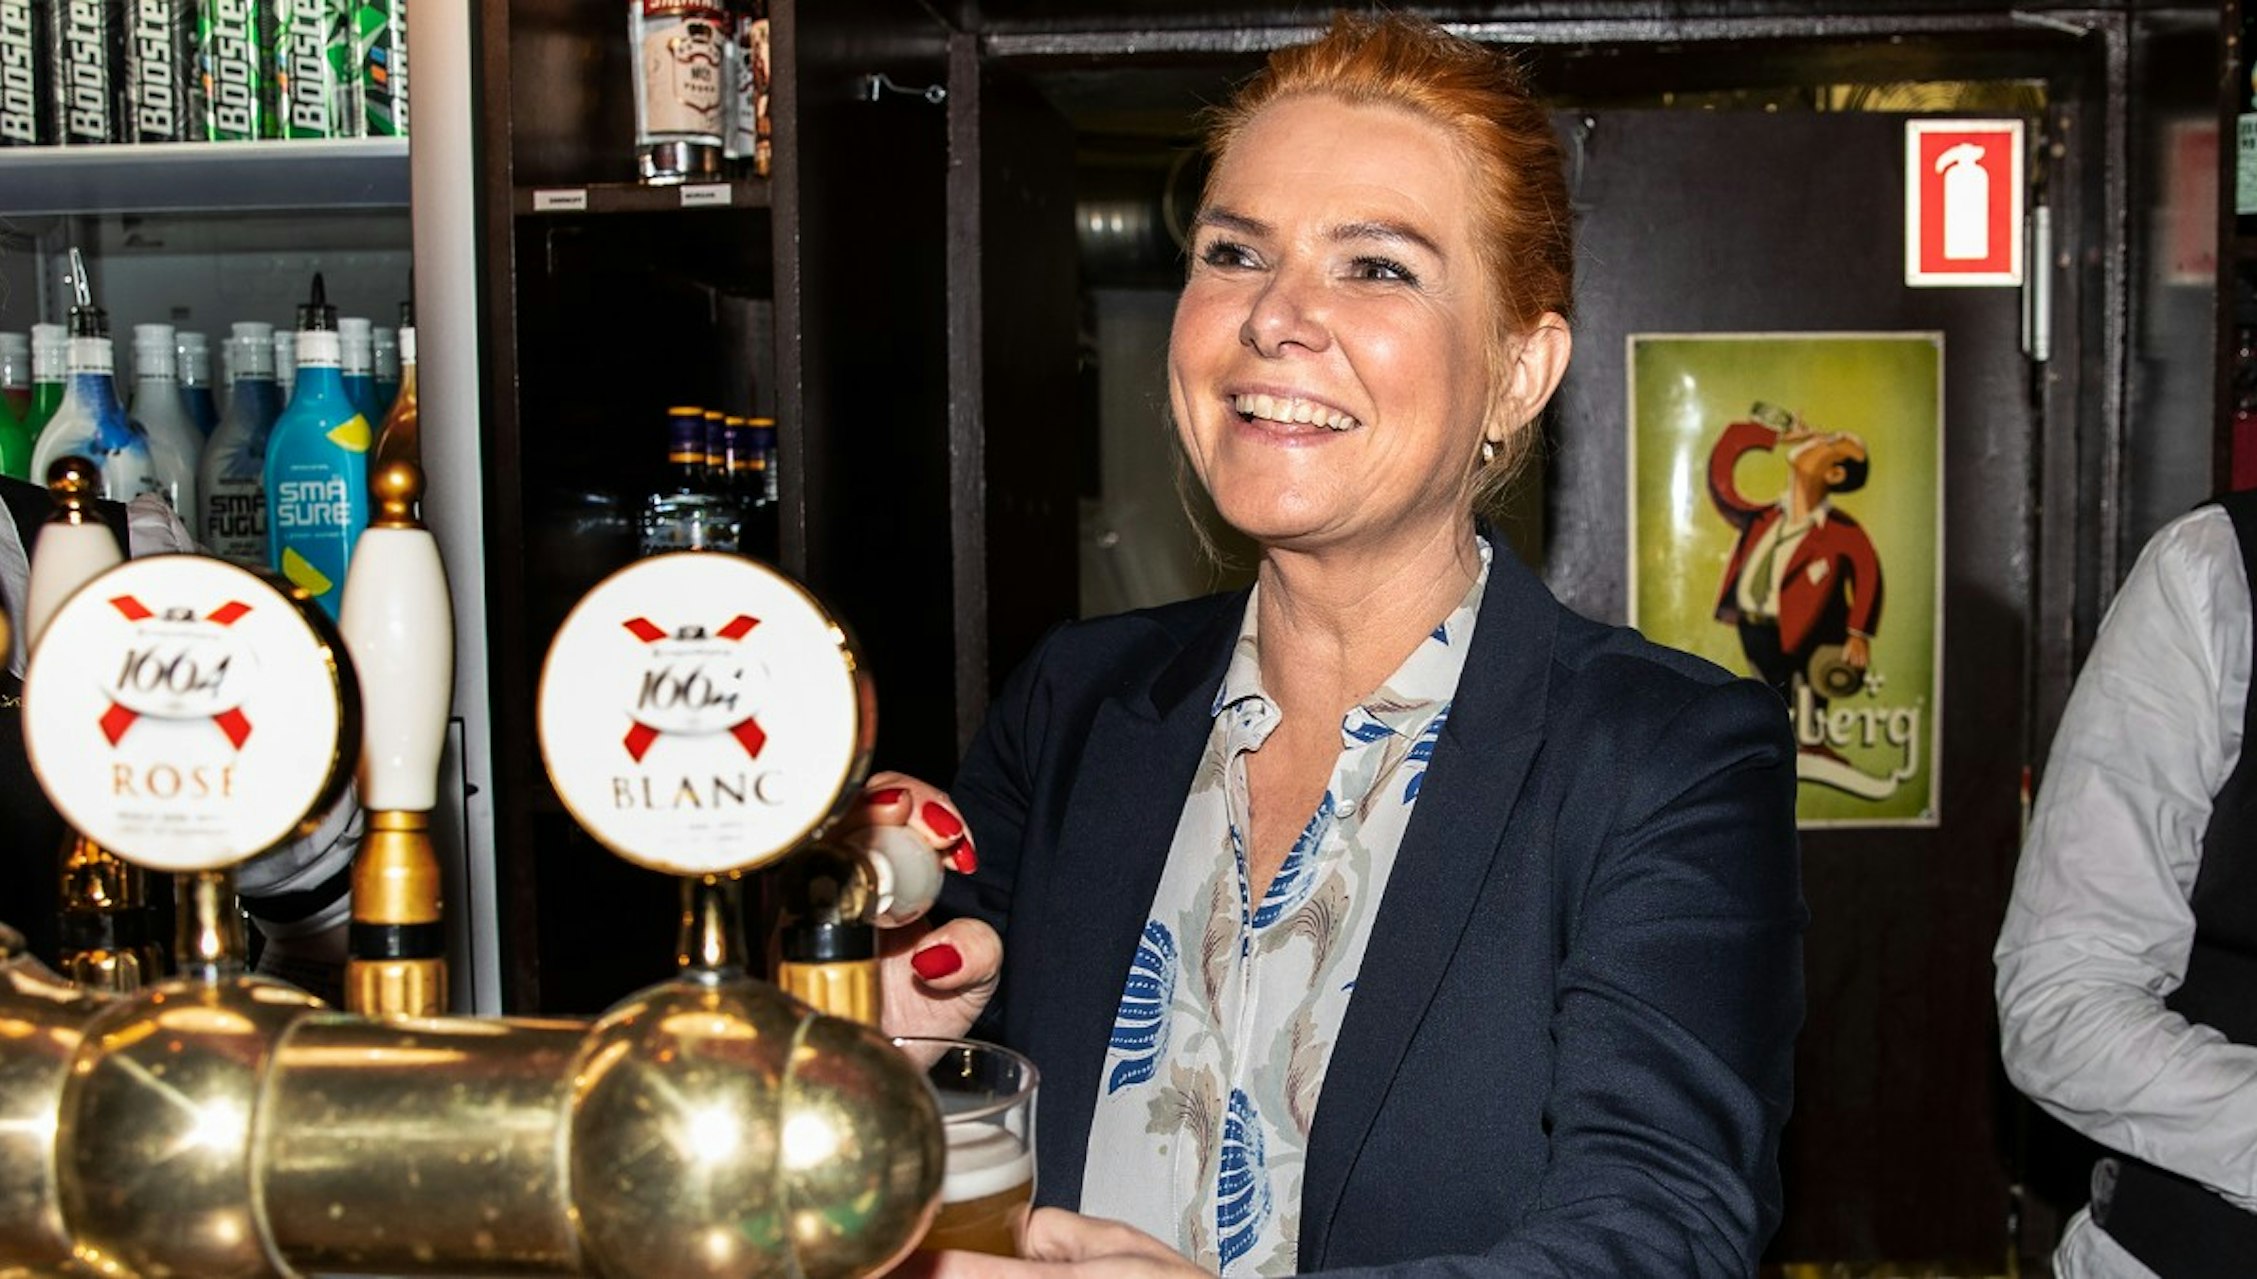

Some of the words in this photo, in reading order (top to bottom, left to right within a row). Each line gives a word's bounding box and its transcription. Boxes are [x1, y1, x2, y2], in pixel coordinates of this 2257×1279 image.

[66, 0, 105, 138] Booste
[136, 0, 174, 136] Booste
[213, 0, 250, 133] Booste
[289, 0, 326, 131] Booste
[277, 502, 351, 527] SURE
[612, 771, 785, 810] BLANC
[1788, 683, 1924, 780] berg
